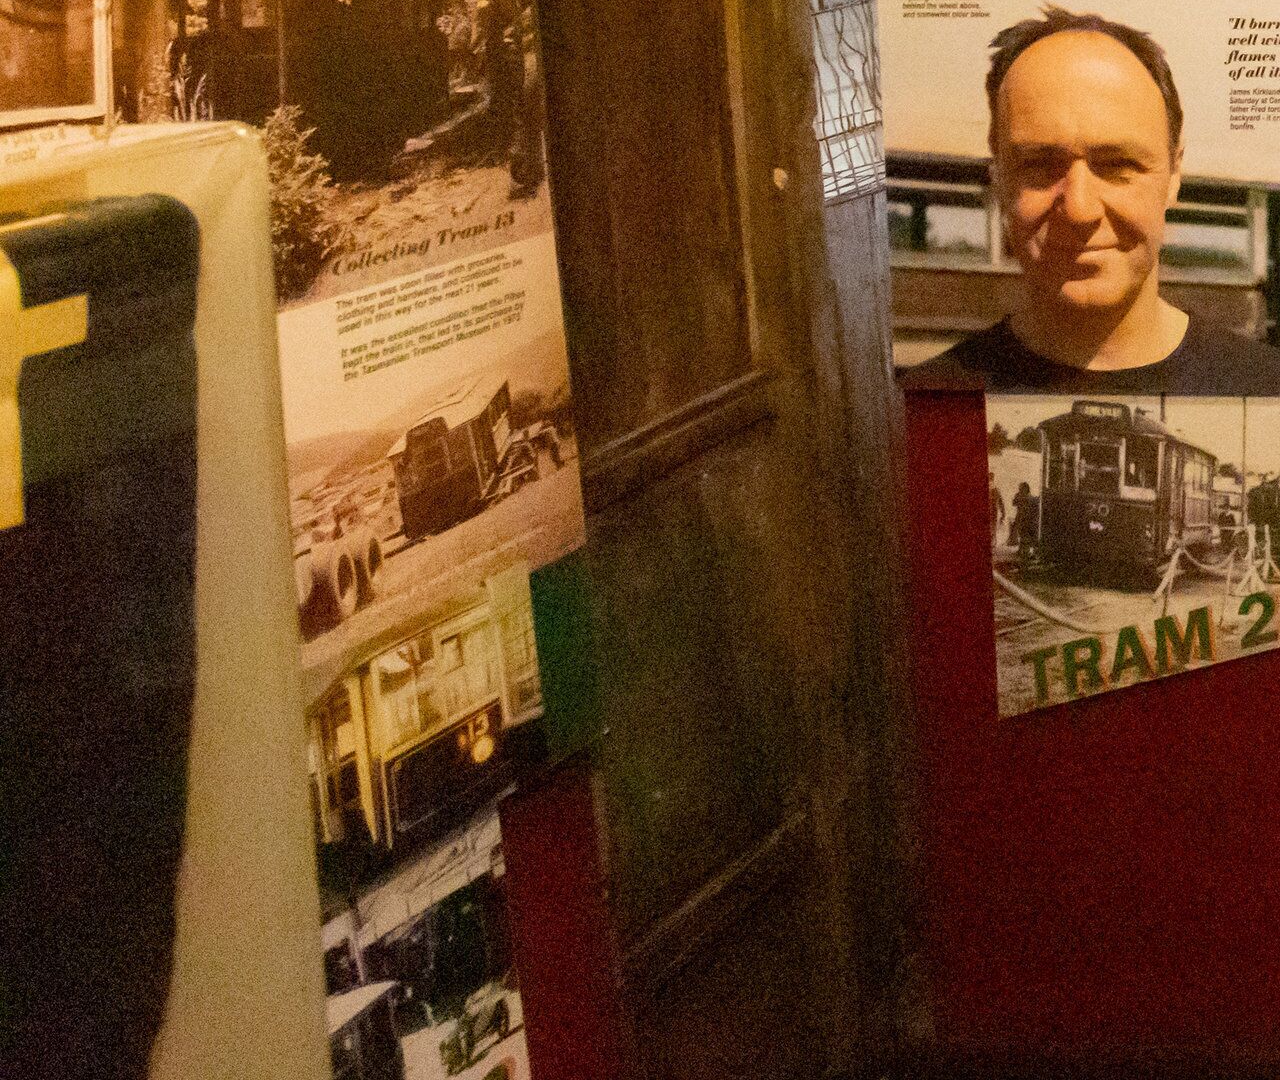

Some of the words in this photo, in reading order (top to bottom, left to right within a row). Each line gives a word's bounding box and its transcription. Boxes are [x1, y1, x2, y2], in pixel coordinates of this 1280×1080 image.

[1229, 17, 1246, 30] "It
[1227, 34, 1258, 46] well
[1224, 50, 1276, 64] flames
[1228, 66, 1245, 81] of
[1245, 66, 1266, 78] all
[332, 238, 431, 276] Collecting
[438, 223, 490, 246] Tram
[456, 324, 491, 341] Museum
[1020, 606, 1217, 703] TRAM
